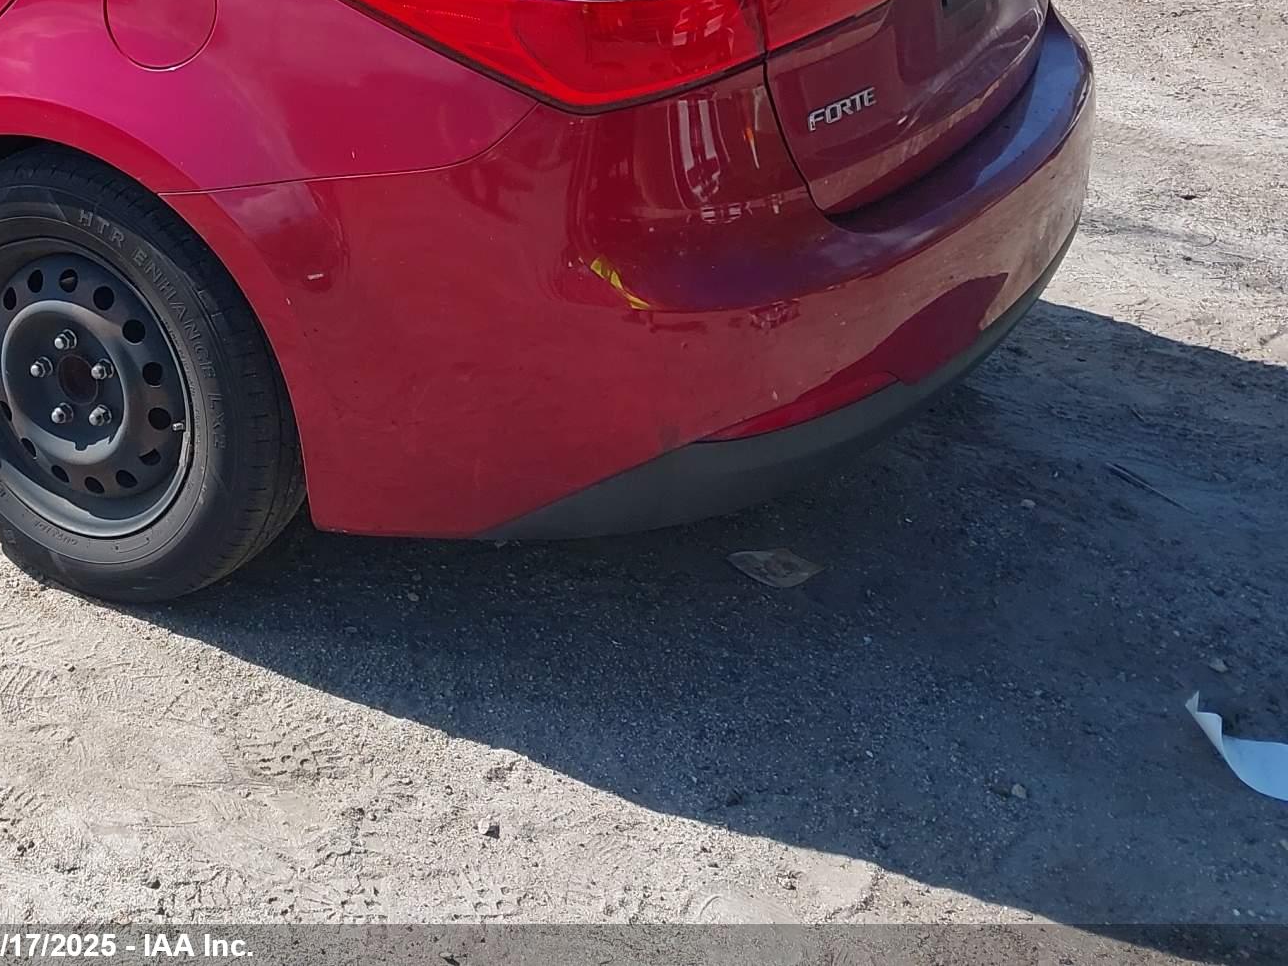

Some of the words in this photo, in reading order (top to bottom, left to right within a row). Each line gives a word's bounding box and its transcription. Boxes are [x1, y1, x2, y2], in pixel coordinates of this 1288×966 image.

[808, 87, 876, 131] FORTE
[78, 209, 125, 248] HTR
[134, 248, 216, 378] ENHANCE
